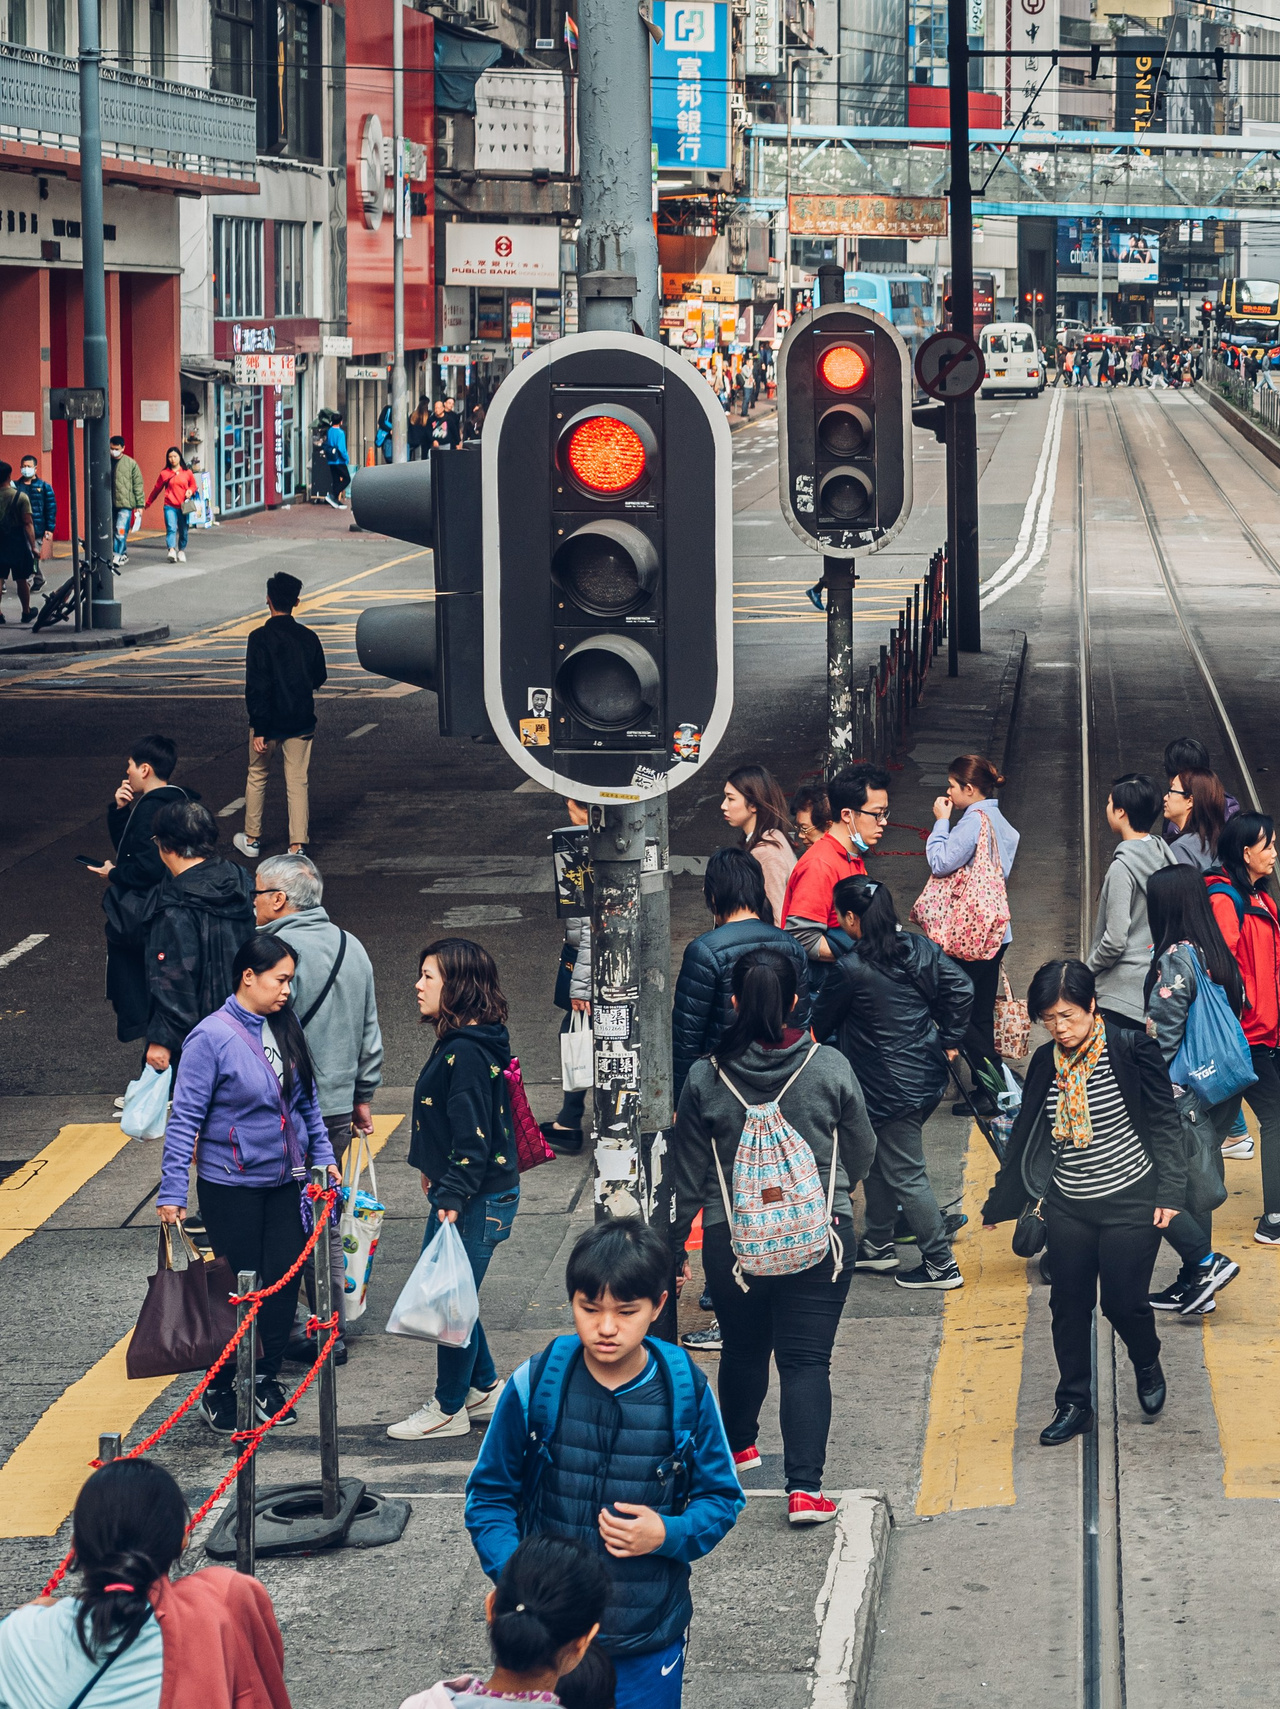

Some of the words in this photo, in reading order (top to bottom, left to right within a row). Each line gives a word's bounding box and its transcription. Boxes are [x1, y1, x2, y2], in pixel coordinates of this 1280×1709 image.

[677, 57, 702, 160] 富邦銀行
[1195, 1065, 1217, 1080] TGC
